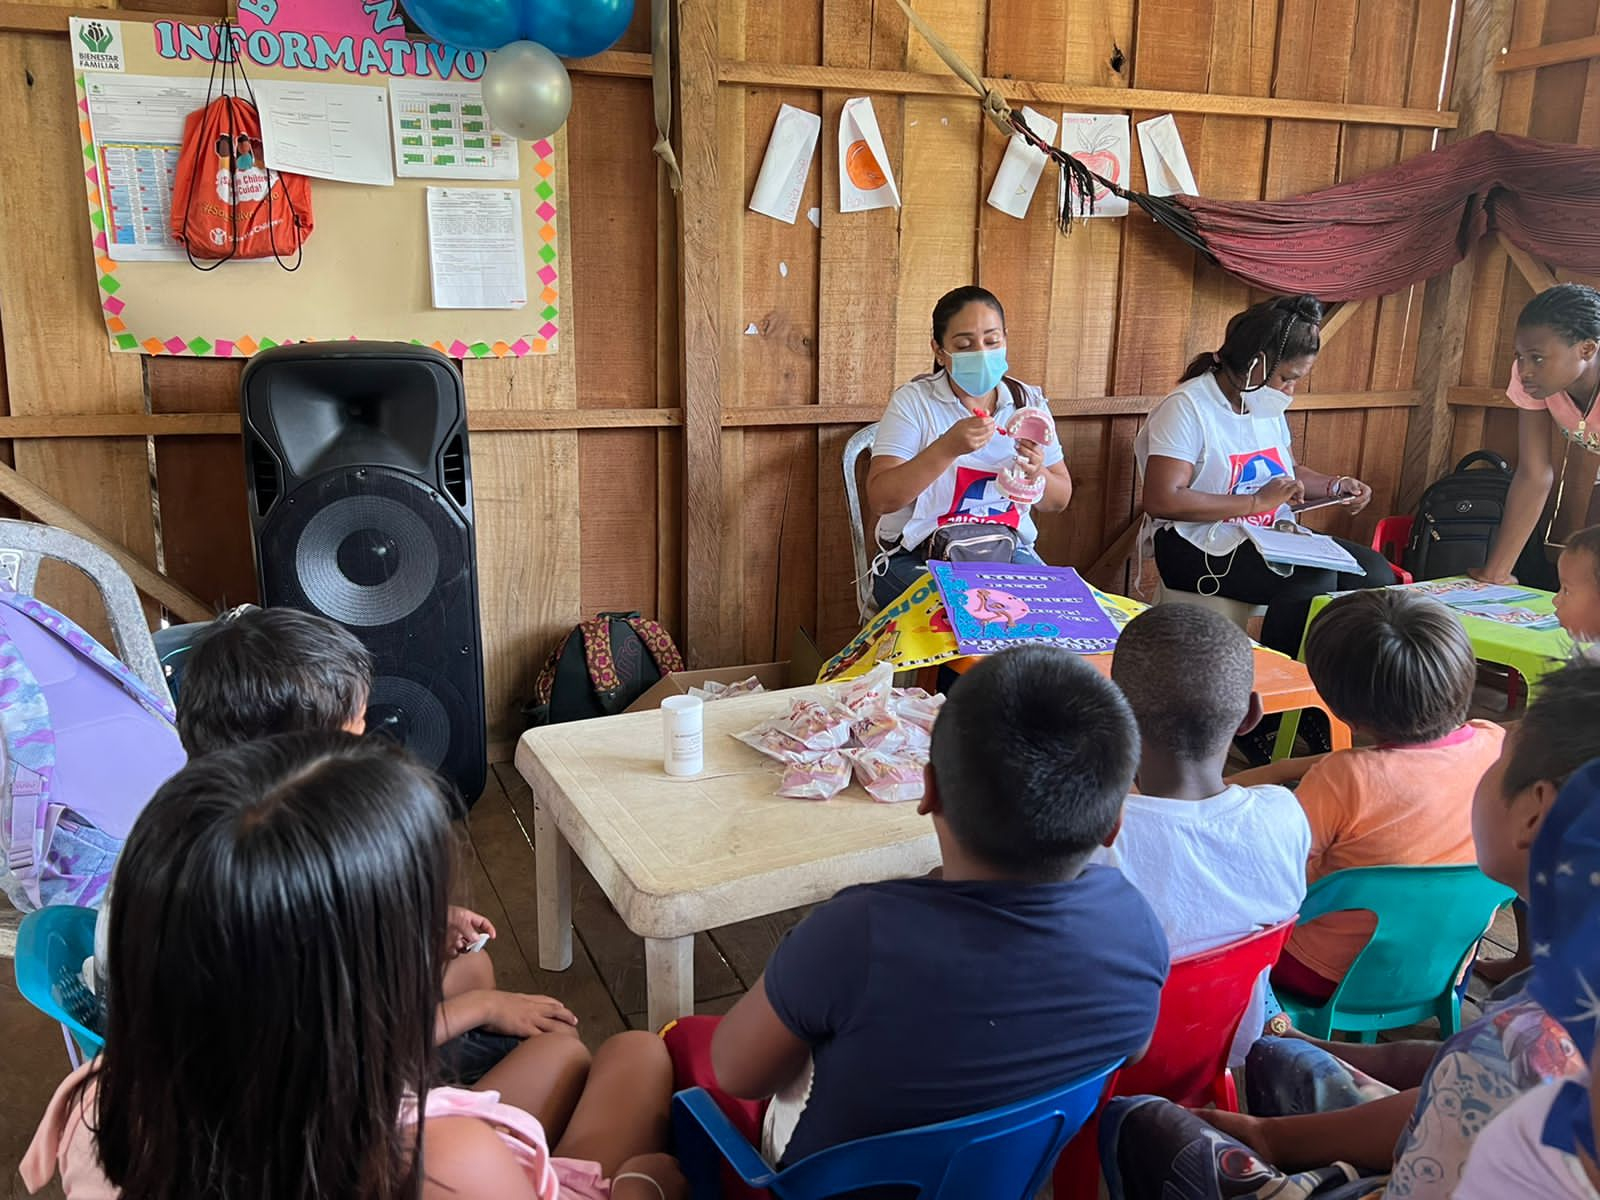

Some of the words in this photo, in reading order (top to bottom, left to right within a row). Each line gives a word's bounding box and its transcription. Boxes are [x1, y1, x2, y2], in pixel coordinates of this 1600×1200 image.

[154, 22, 486, 79] INFORMATIVO
[79, 53, 119, 62] BIENESTAR
[79, 61, 120, 70] FAMILIAR
